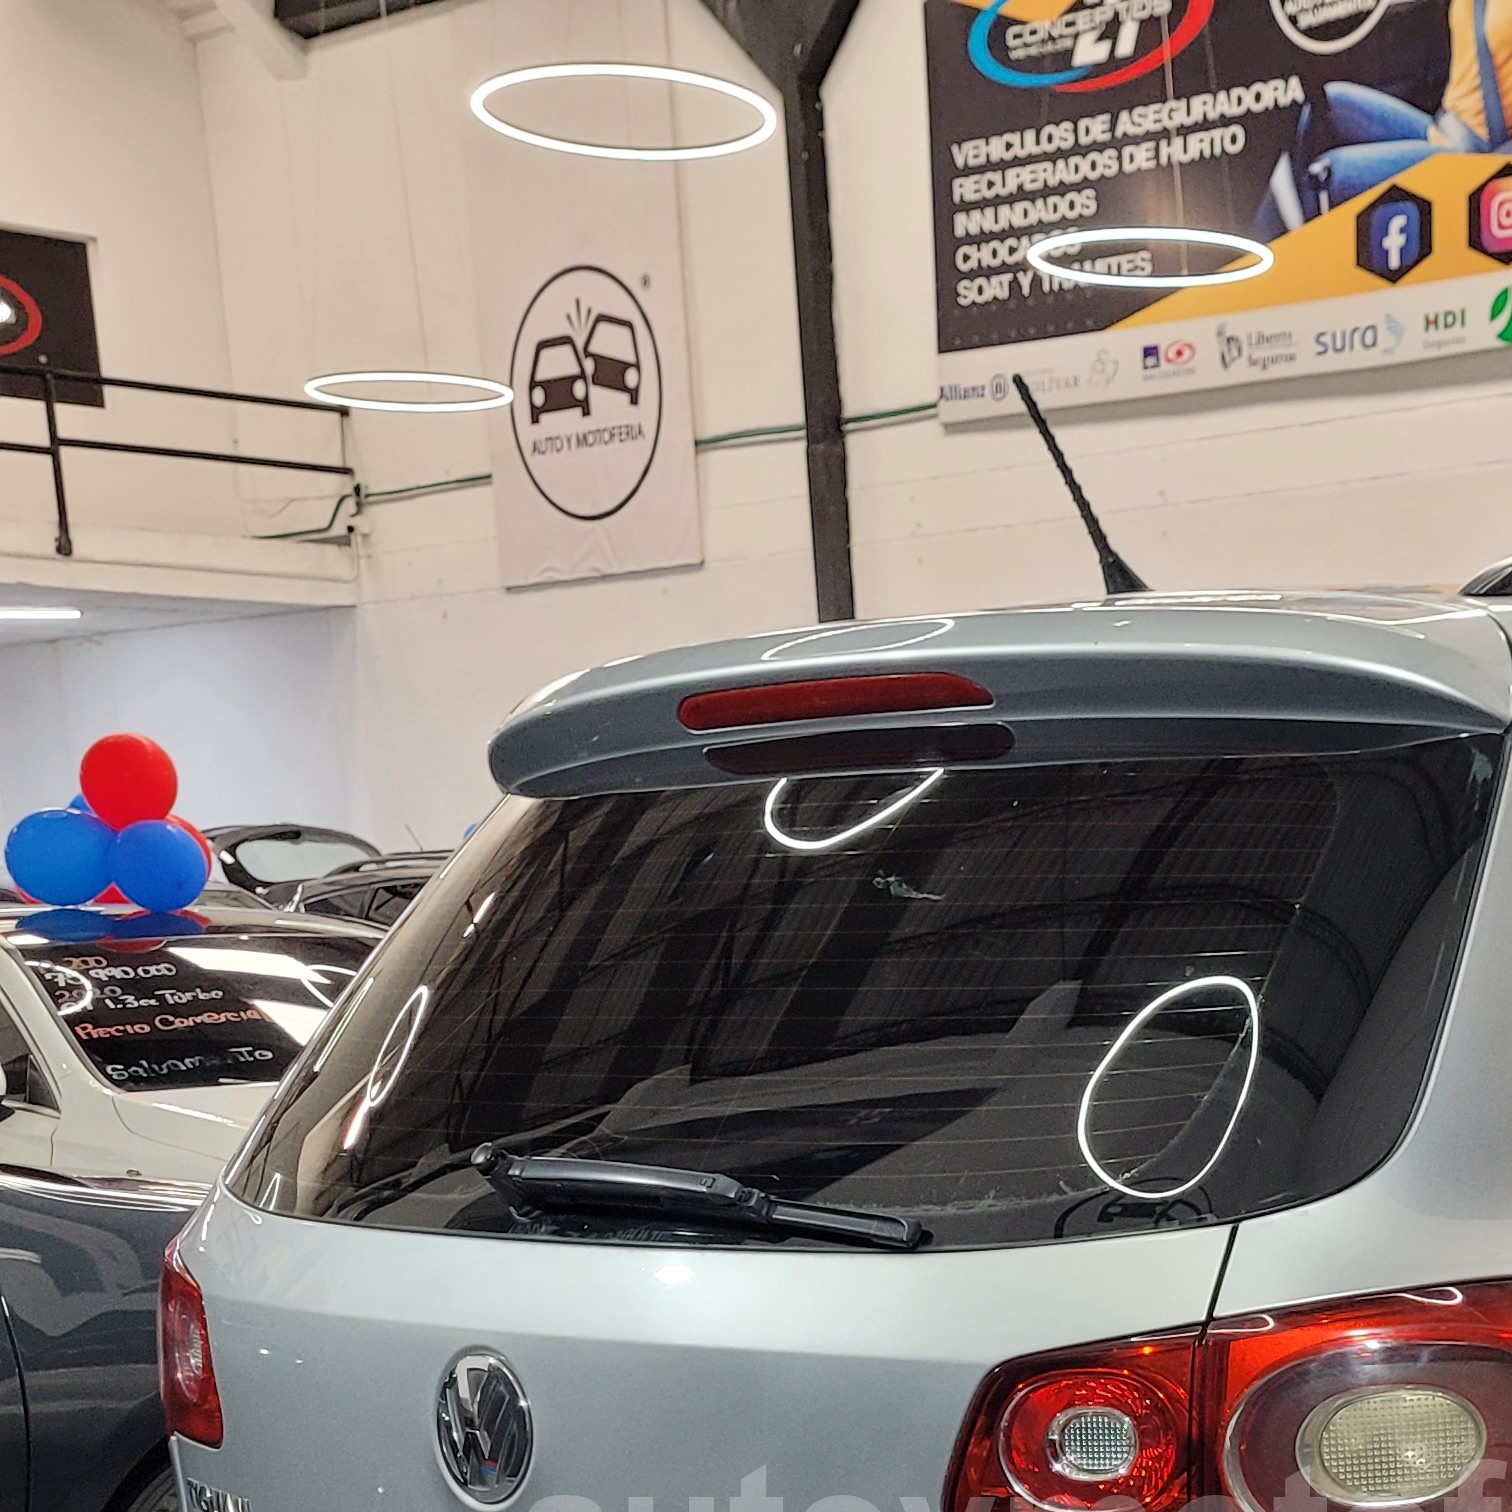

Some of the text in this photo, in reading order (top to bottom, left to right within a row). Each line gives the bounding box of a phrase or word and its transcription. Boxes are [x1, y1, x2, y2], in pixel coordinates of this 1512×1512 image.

[950, 74, 1306, 171] VEHICULOS DE ASEGURADORA
[952, 123, 1246, 205] RECUPERADOS DE HURTO
[953, 187, 1098, 239] INNUNDADOS
[956, 272, 1014, 308] SOAT
[1016, 271, 1034, 298] Y
[1423, 308, 1467, 334] HDI
[1314, 324, 1378, 356] sura
[531, 436, 565, 456] AUTO
[575, 422, 646, 449] MOTOFERIA
[154, 988, 224, 1005] Turbo
[74, 1023, 152, 1040] Precio
